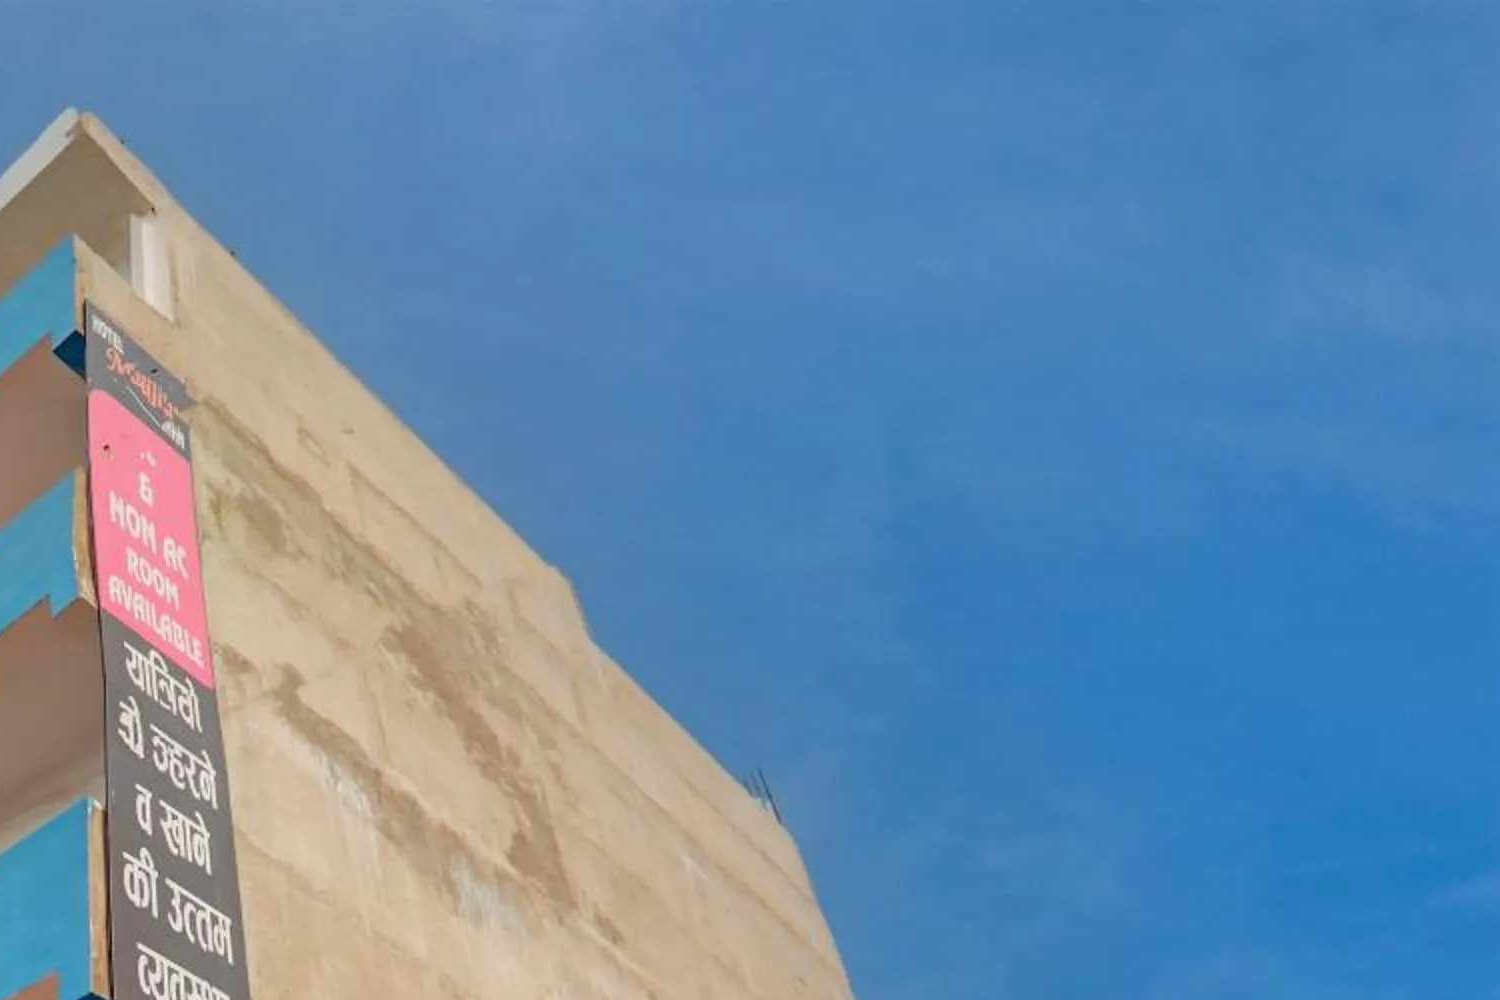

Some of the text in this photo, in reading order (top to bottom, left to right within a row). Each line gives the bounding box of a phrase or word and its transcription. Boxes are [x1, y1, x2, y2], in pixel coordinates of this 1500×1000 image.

[109, 490, 157, 555] NON
[126, 546, 180, 612] ROOM
[107, 575, 206, 668] AVAILABLE
[159, 800, 213, 876] खाने
[121, 847, 234, 966] की उत्तम
